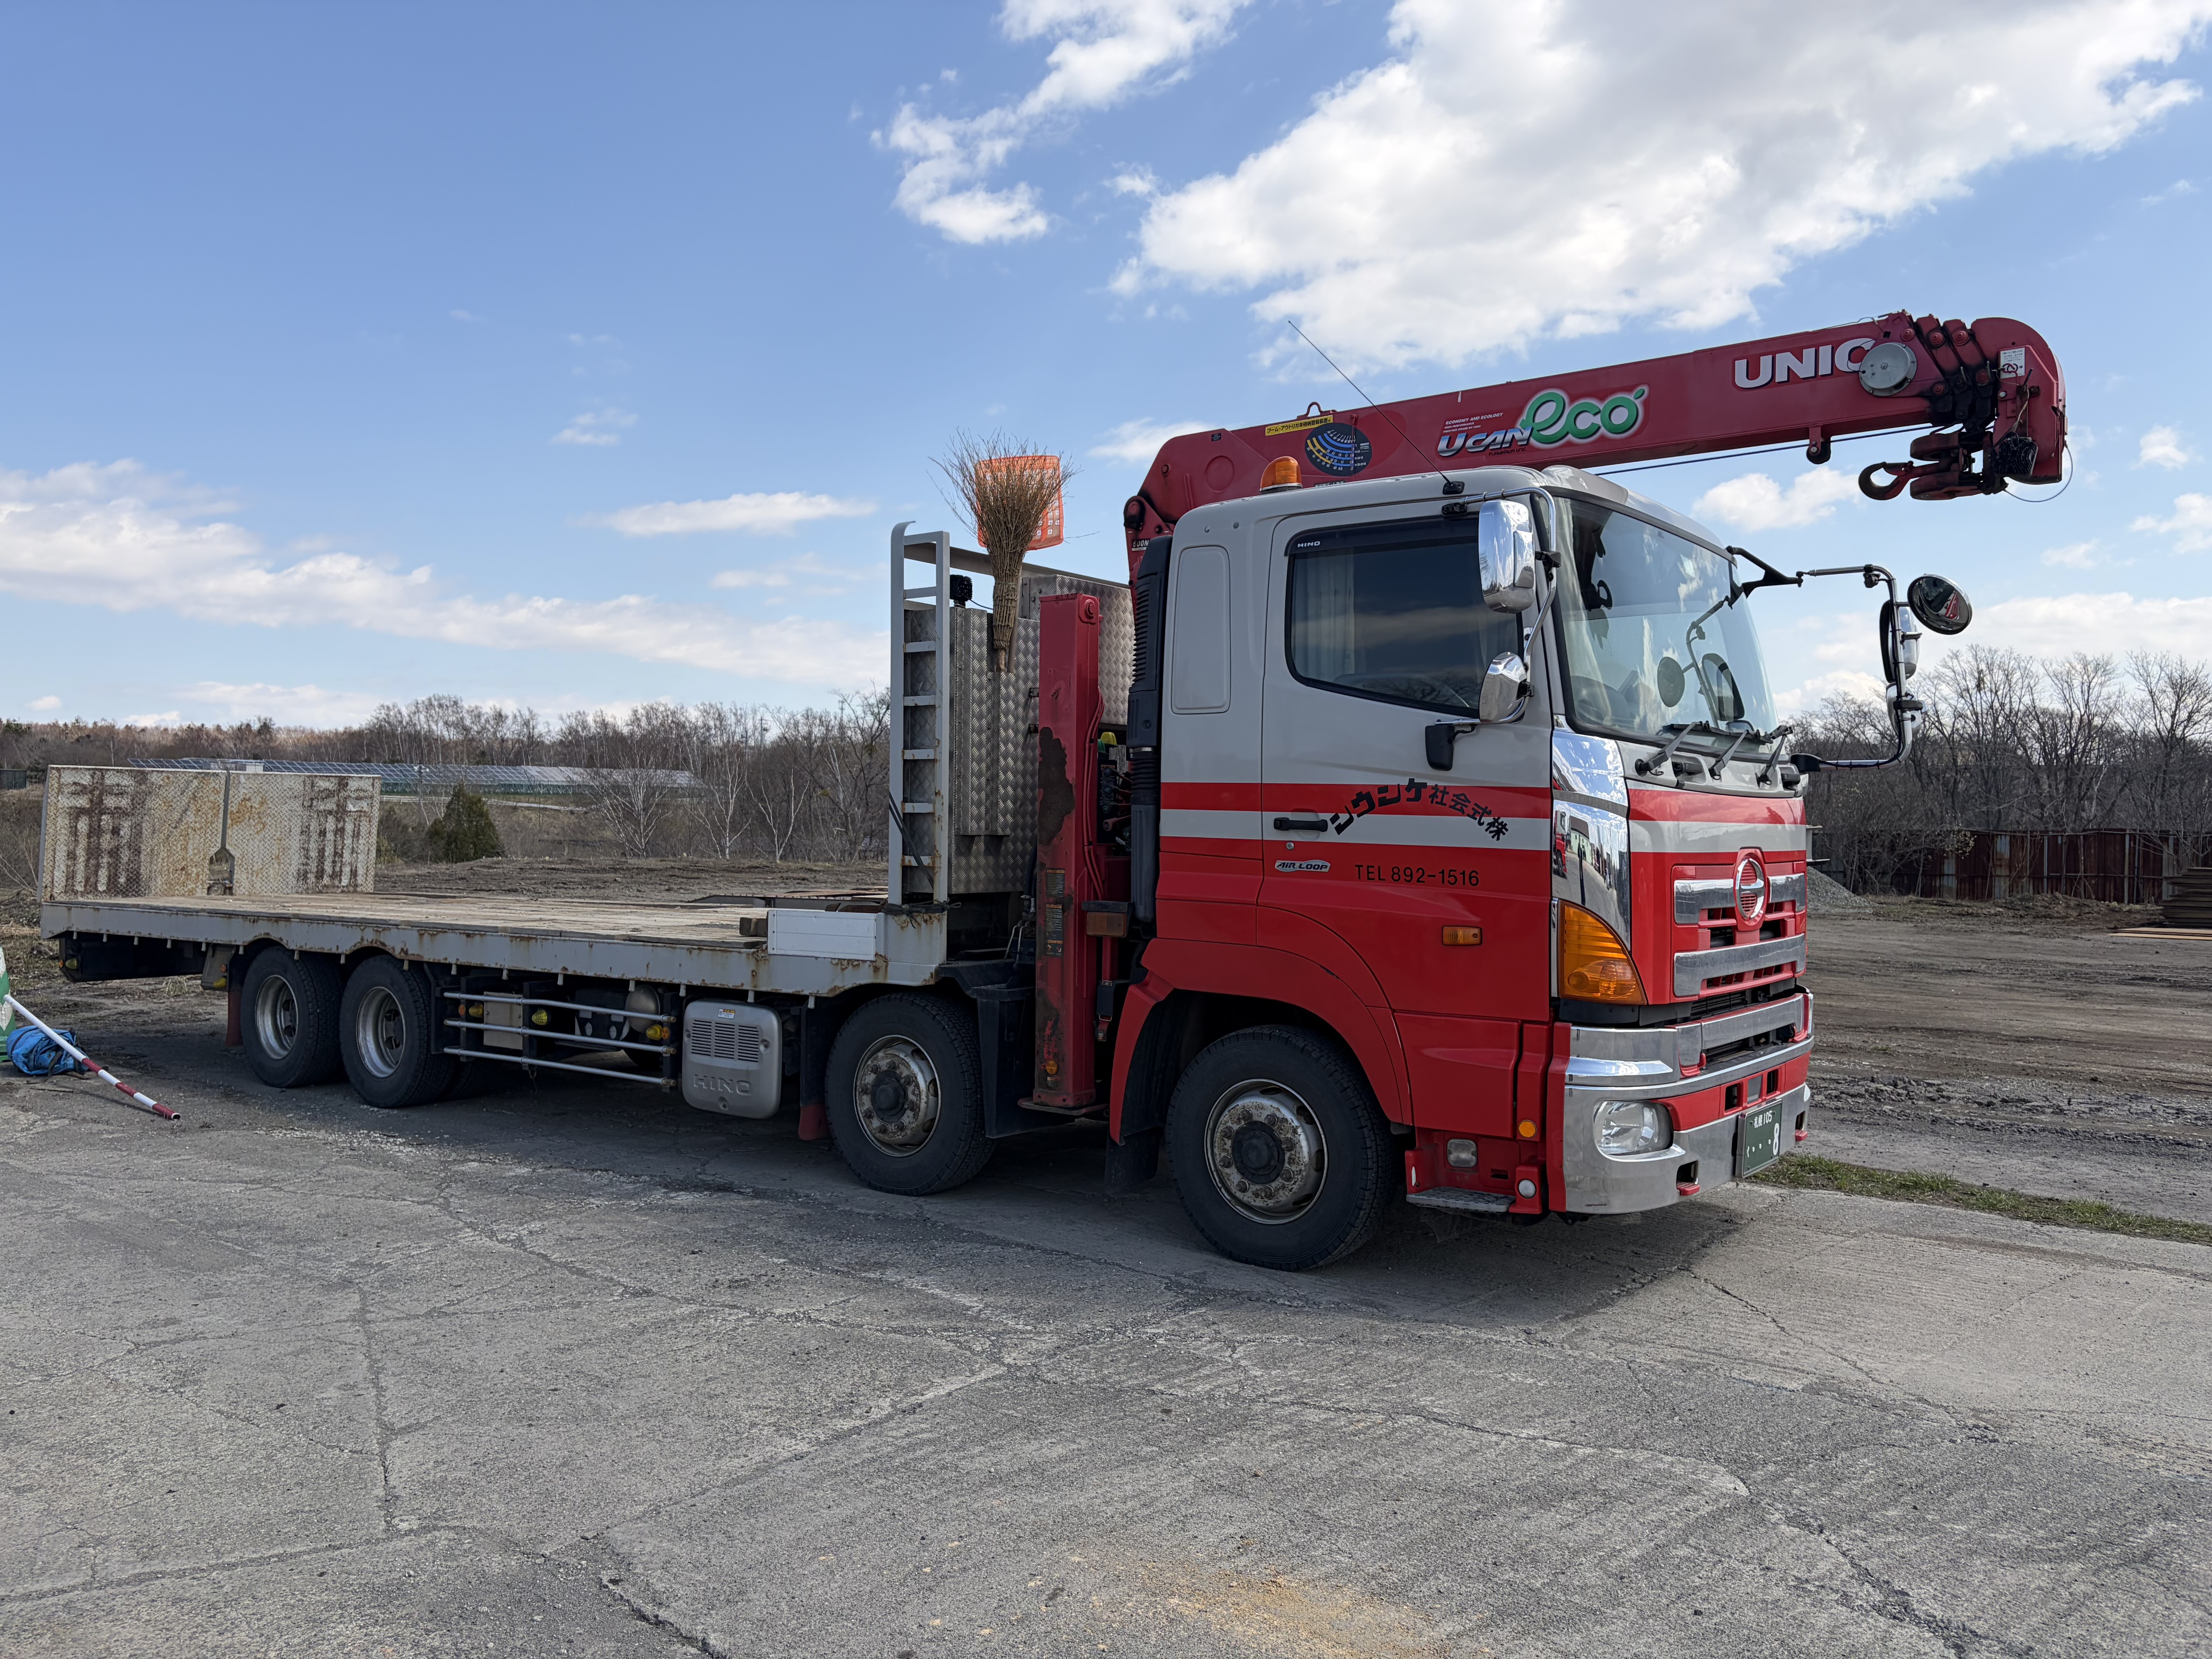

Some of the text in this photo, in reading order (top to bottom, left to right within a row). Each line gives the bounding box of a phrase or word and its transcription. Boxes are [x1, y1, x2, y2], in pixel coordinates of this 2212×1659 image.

[1735, 338, 1875, 388] UNIC
[1519, 391, 1640, 444] eco
[1437, 426, 1533, 457] UCAN
[1355, 864, 1480, 887] TEL 892-1516
[694, 1073, 752, 1096] HINO
